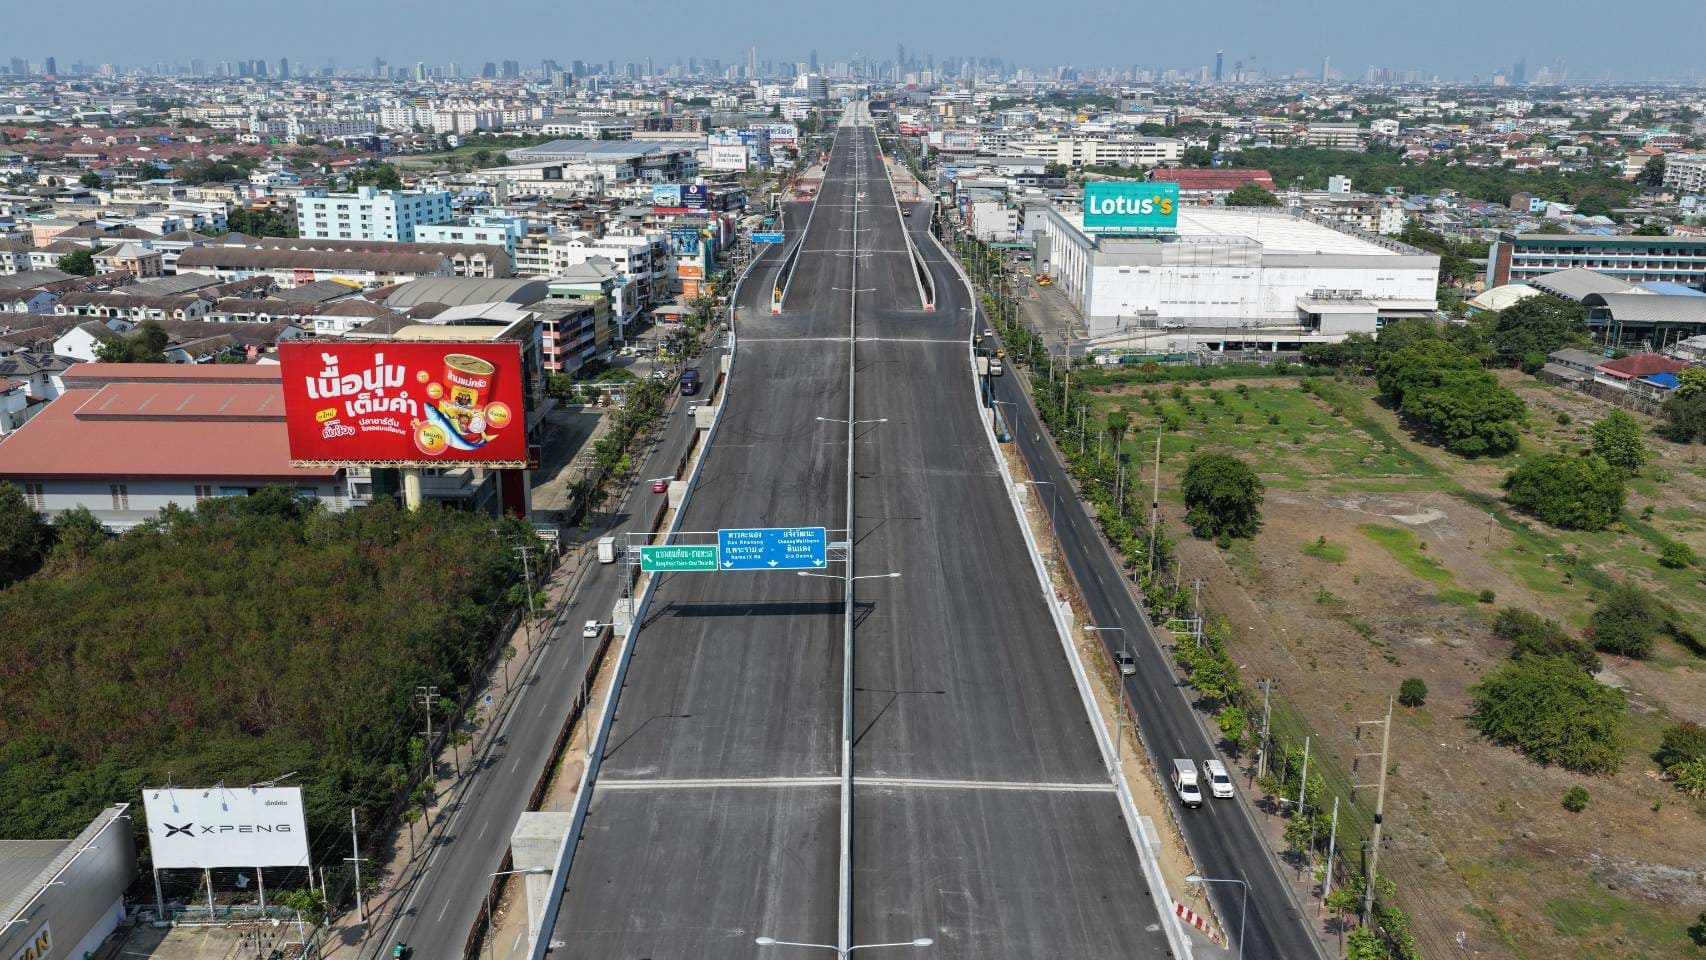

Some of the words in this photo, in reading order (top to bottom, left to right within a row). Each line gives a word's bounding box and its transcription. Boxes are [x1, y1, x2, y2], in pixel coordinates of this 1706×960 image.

[1090, 195, 1172, 214] Lotus's
[305, 352, 406, 399] เนื้อนุ่ม
[345, 391, 418, 417] เต็มคำ
[201, 824, 291, 834] XPENG
